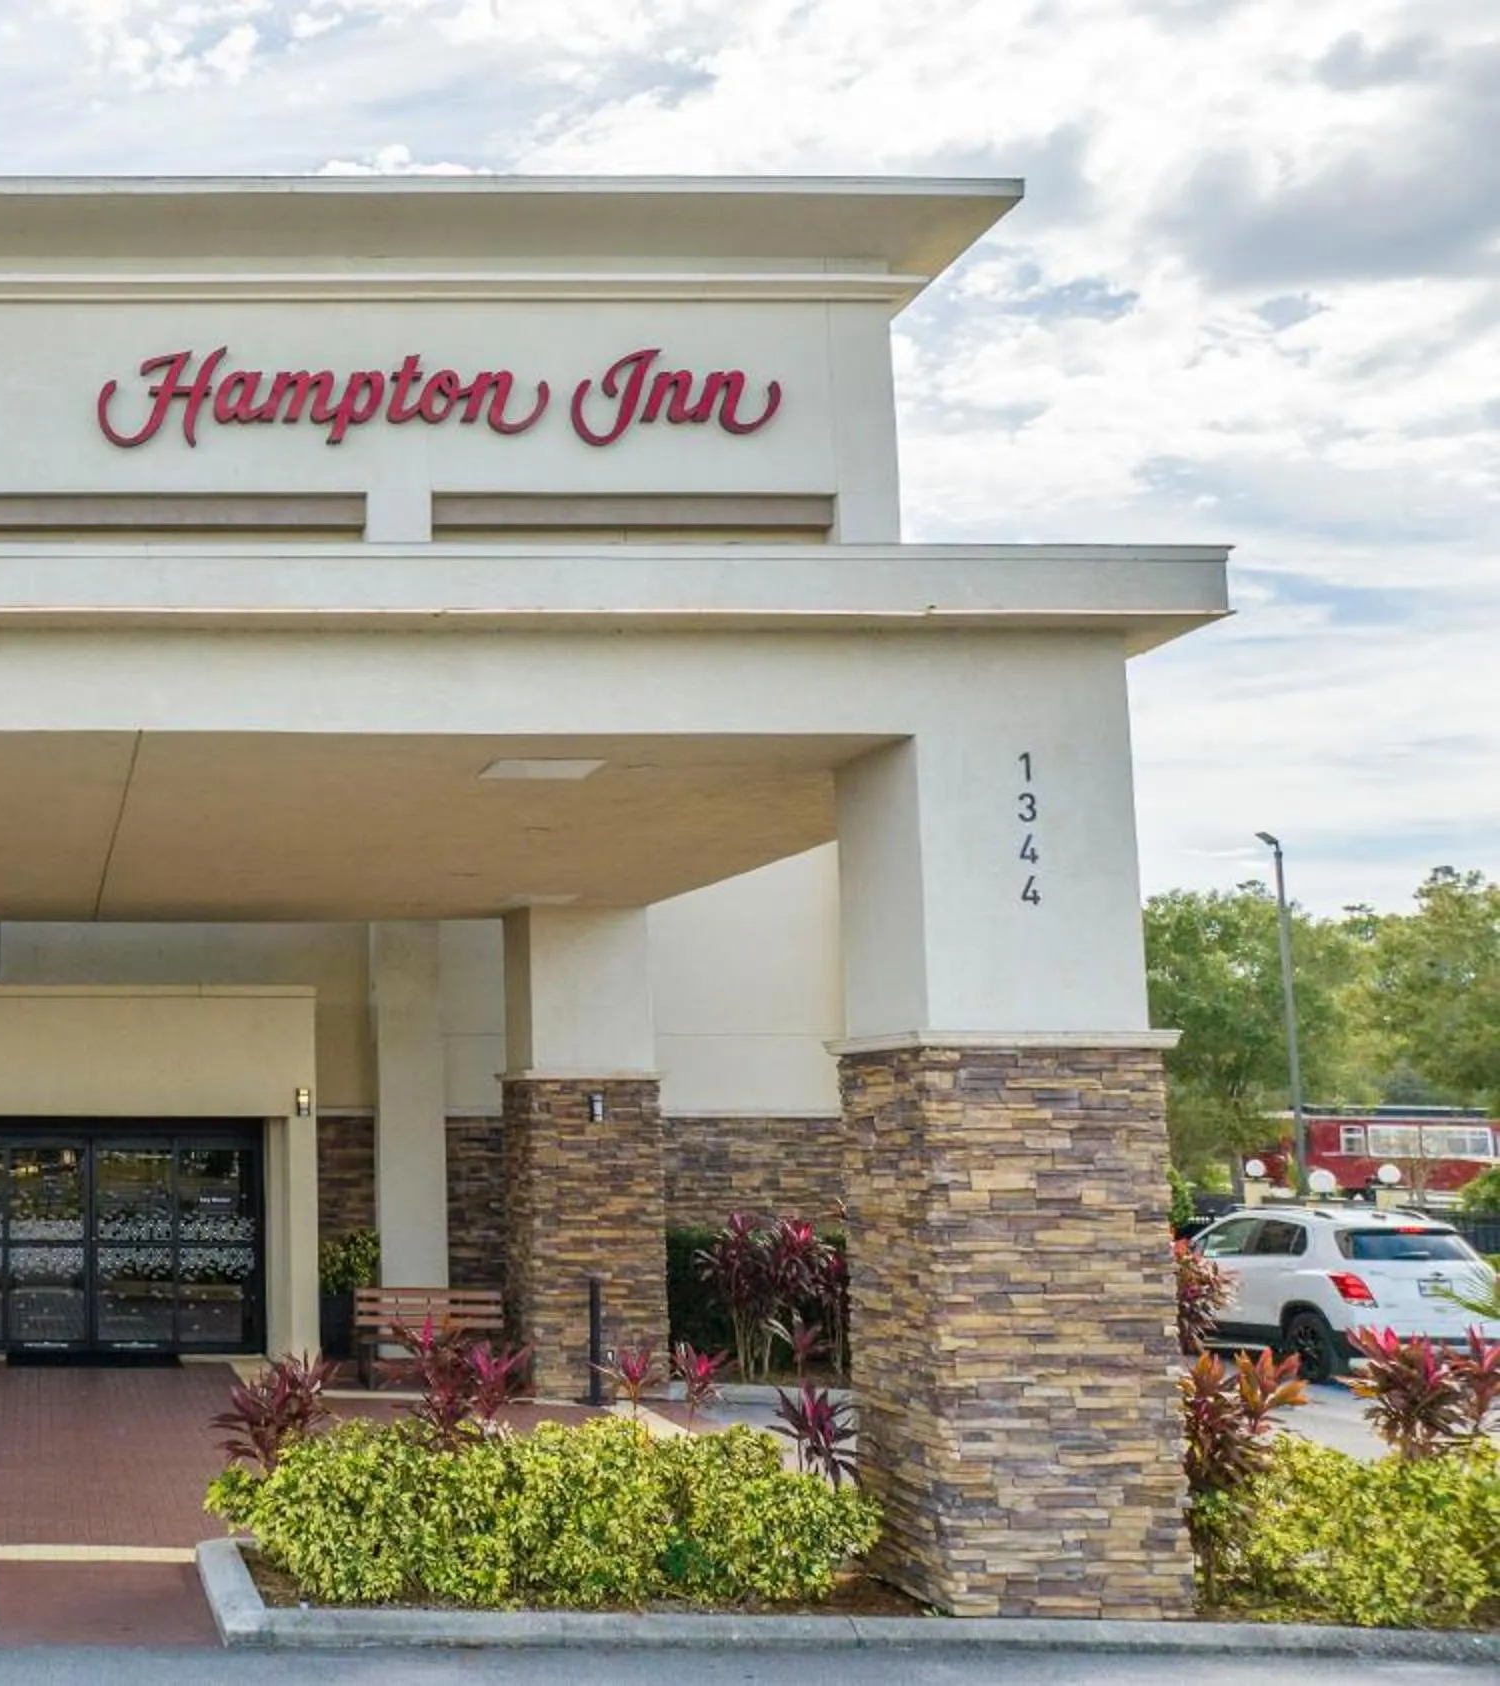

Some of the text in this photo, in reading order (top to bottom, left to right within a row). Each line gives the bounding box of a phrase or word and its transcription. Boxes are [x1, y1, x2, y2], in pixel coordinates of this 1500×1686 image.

[98, 346, 782, 448] Hampton Inn
[1017, 751, 1042, 906] 1344
